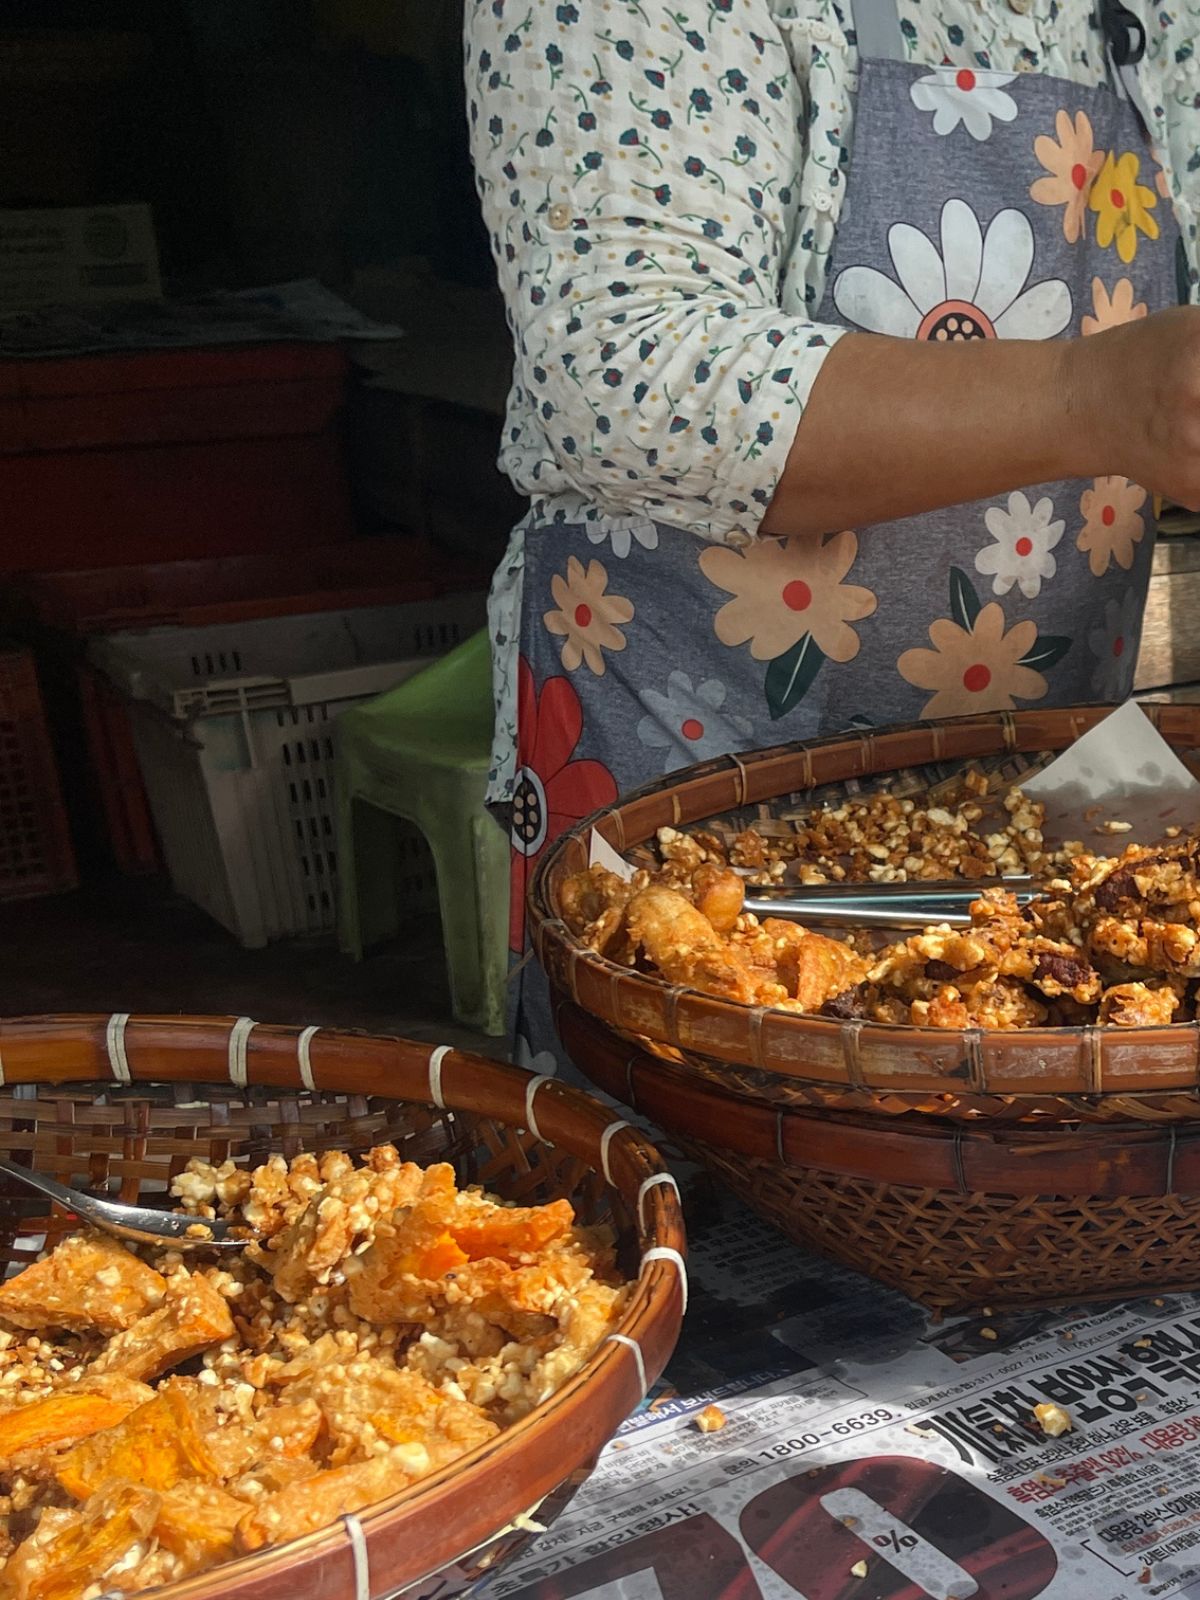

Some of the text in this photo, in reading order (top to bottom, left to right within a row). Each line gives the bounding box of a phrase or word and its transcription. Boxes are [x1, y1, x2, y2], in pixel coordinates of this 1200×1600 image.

[1034, 1357, 1159, 1421] 보양식
[1139, 1423, 1196, 1452] 대용량
[1098, 1520, 1143, 1544] 대용량
